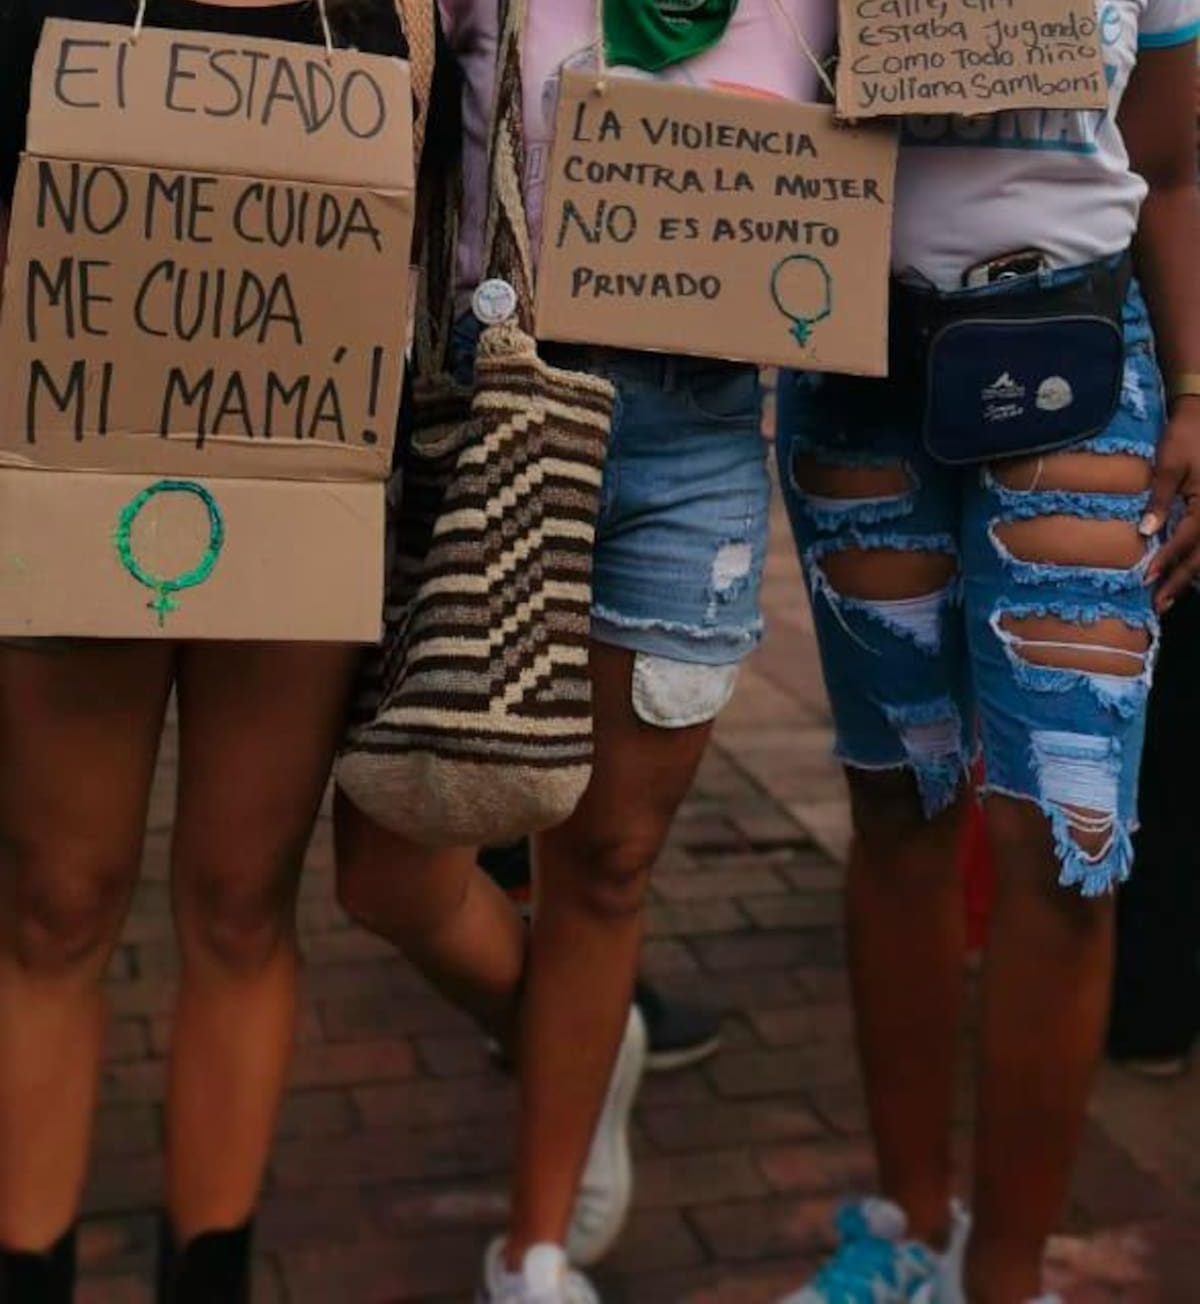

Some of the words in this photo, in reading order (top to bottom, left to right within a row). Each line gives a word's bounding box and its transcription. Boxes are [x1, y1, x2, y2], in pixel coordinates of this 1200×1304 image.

[165, 43, 386, 138] ESTADO
[572, 102, 621, 142] LA
[36, 161, 128, 234] NO
[145, 172, 217, 243] ME
[233, 183, 382, 253] CUIDA
[564, 157, 703, 193] CONTRA
[715, 169, 754, 192] LA
[776, 176, 884, 204] MUJER
[557, 199, 636, 247] NO
[659, 218, 698, 240] ES
[712, 219, 839, 247] ASUNTO
[28, 257, 112, 343] ME
[135, 260, 302, 346] CUIDA
[571, 268, 721, 299] PRIVADO
[27, 359, 111, 445] MI
[161, 346, 383, 450] MAMÁ!
